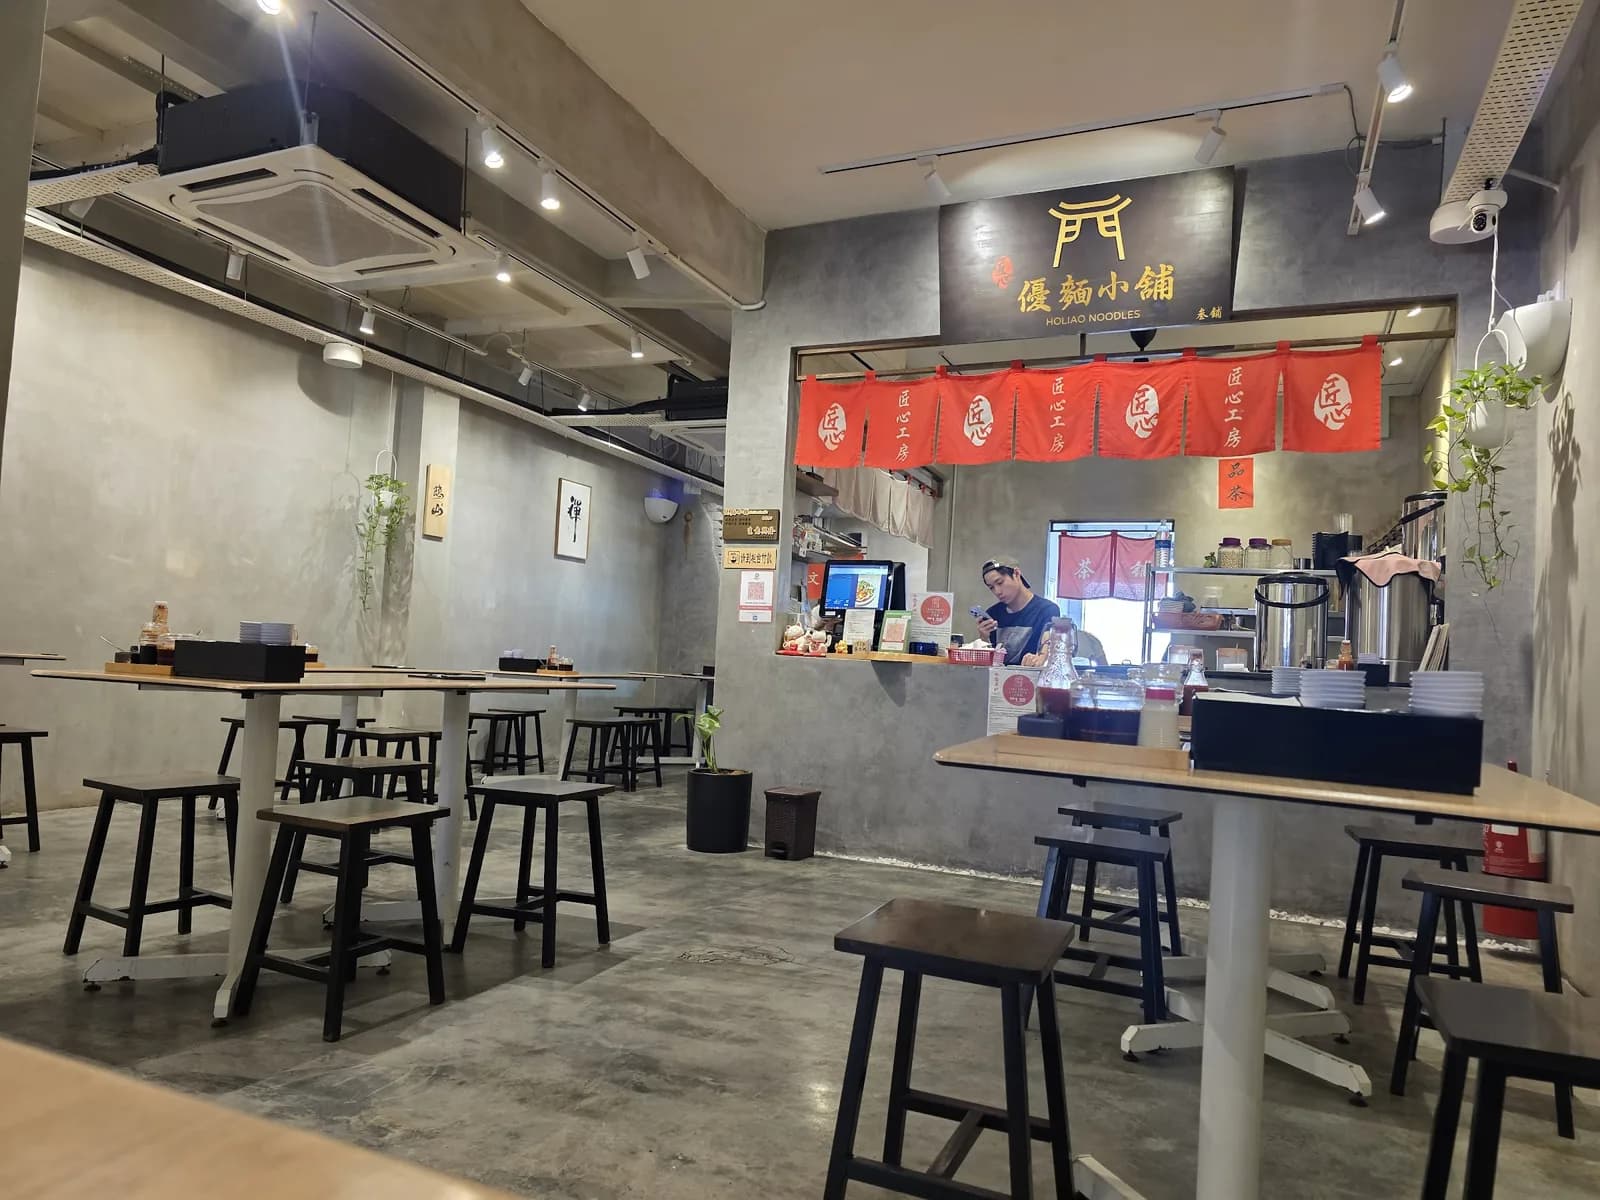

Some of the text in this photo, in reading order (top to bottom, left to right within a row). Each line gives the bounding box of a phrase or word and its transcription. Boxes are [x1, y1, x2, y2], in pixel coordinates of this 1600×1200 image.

[1018, 263, 1175, 312] 優麵小舖
[1046, 309, 1141, 326] HOLIAO NOODLES
[896, 389, 911, 463] 匠心工房
[1050, 376, 1066, 453] 匠心工房
[1224, 366, 1245, 448] 匠心工房
[1227, 462, 1247, 502] 品茶
